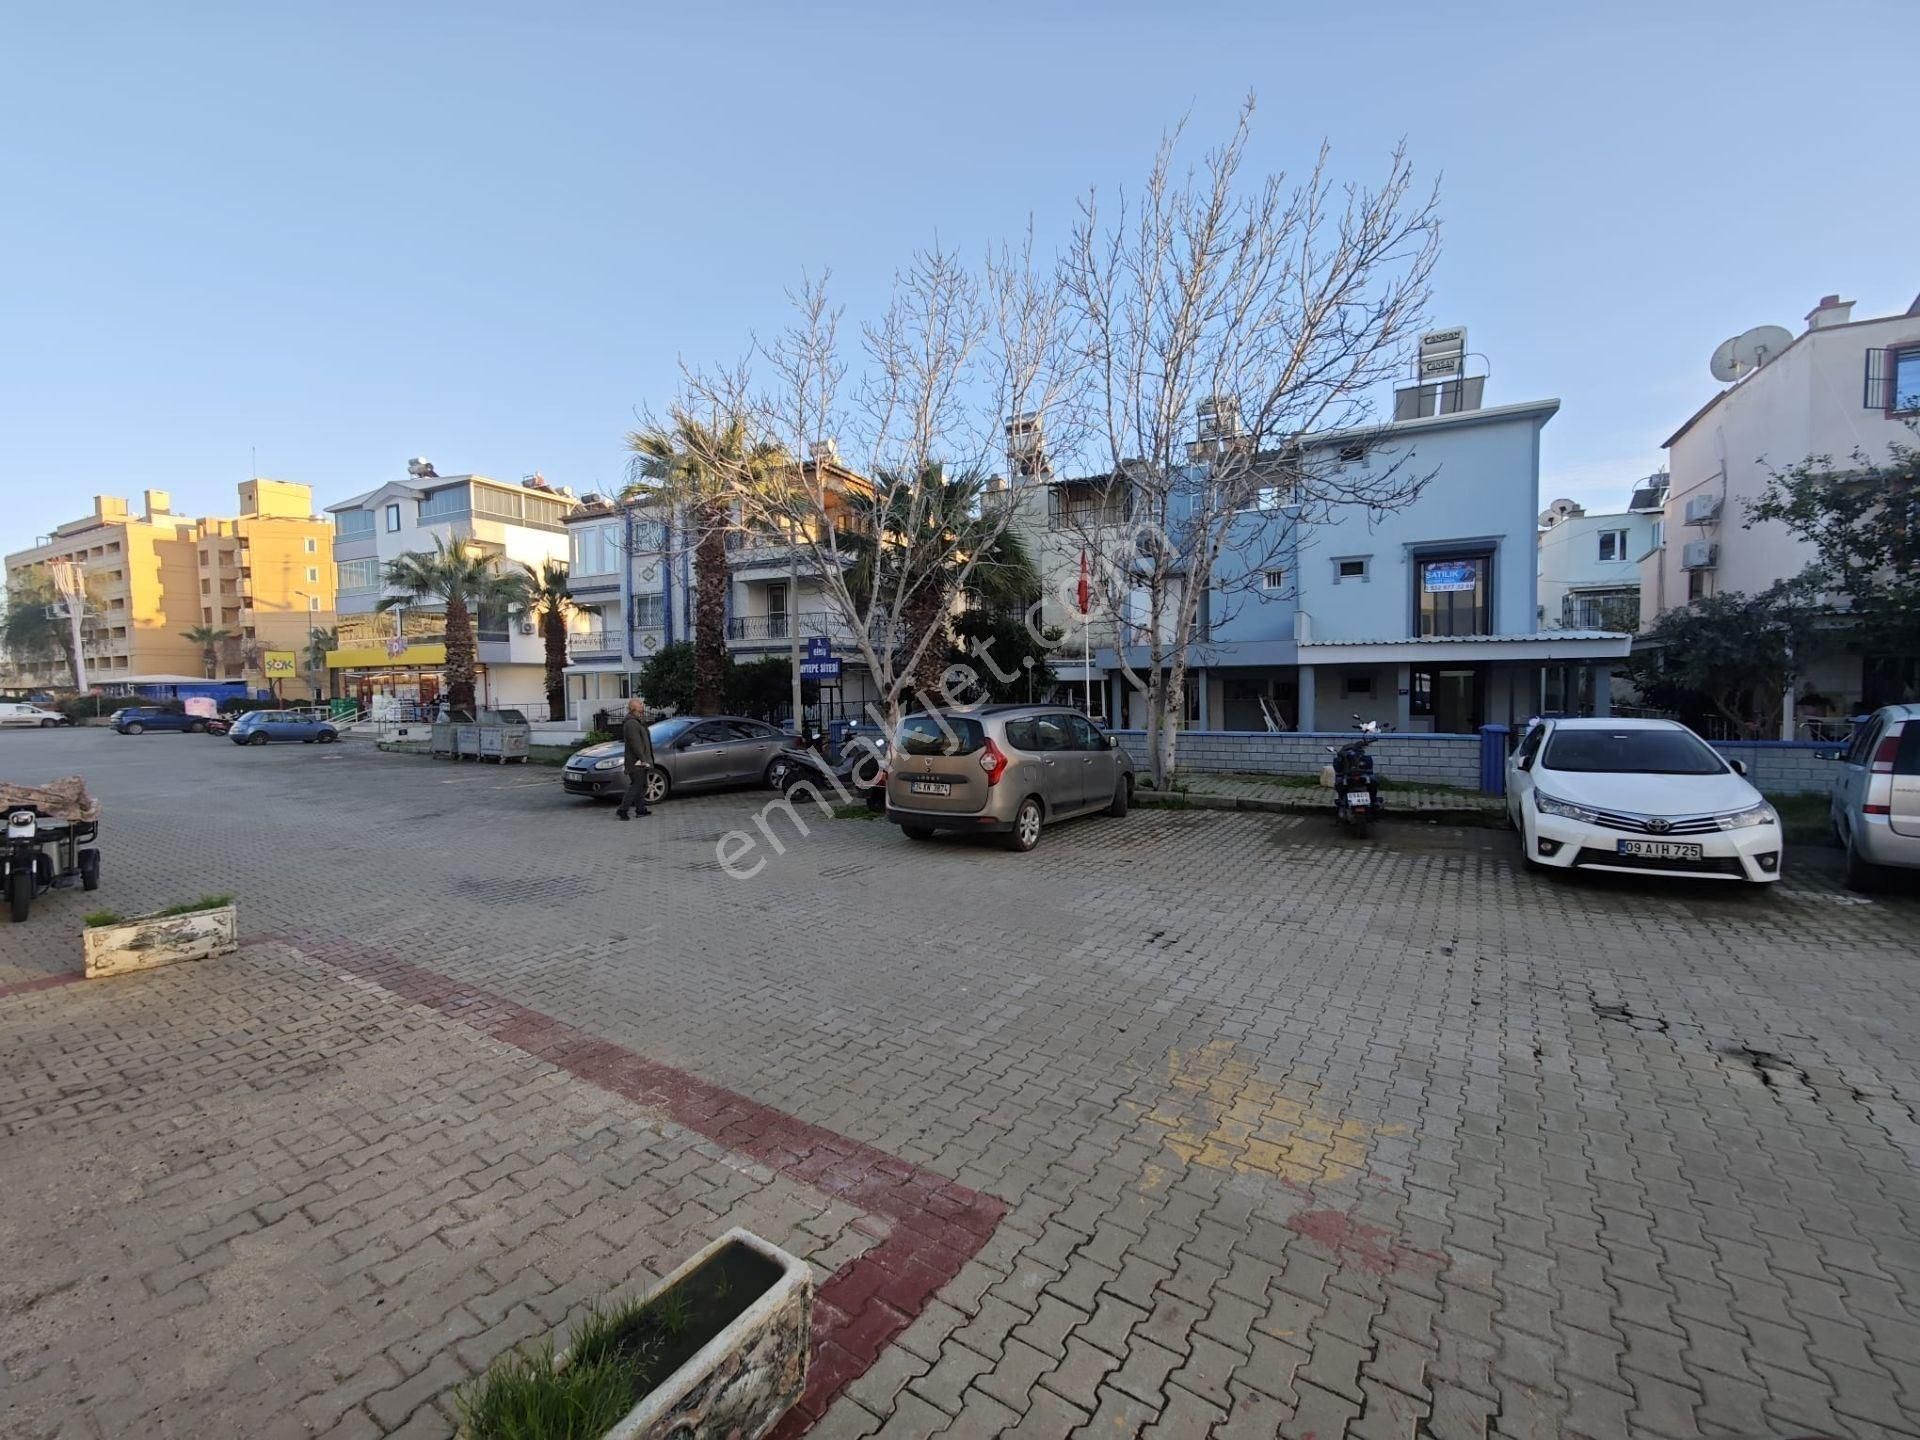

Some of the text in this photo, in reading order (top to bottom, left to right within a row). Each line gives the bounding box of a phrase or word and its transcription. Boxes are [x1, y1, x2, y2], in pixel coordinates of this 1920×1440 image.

[1425, 569, 1459, 579] SATILIK
[820, 661, 839, 673] SİTESİ
[1625, 842, 1699, 857] 09 AIH 725
